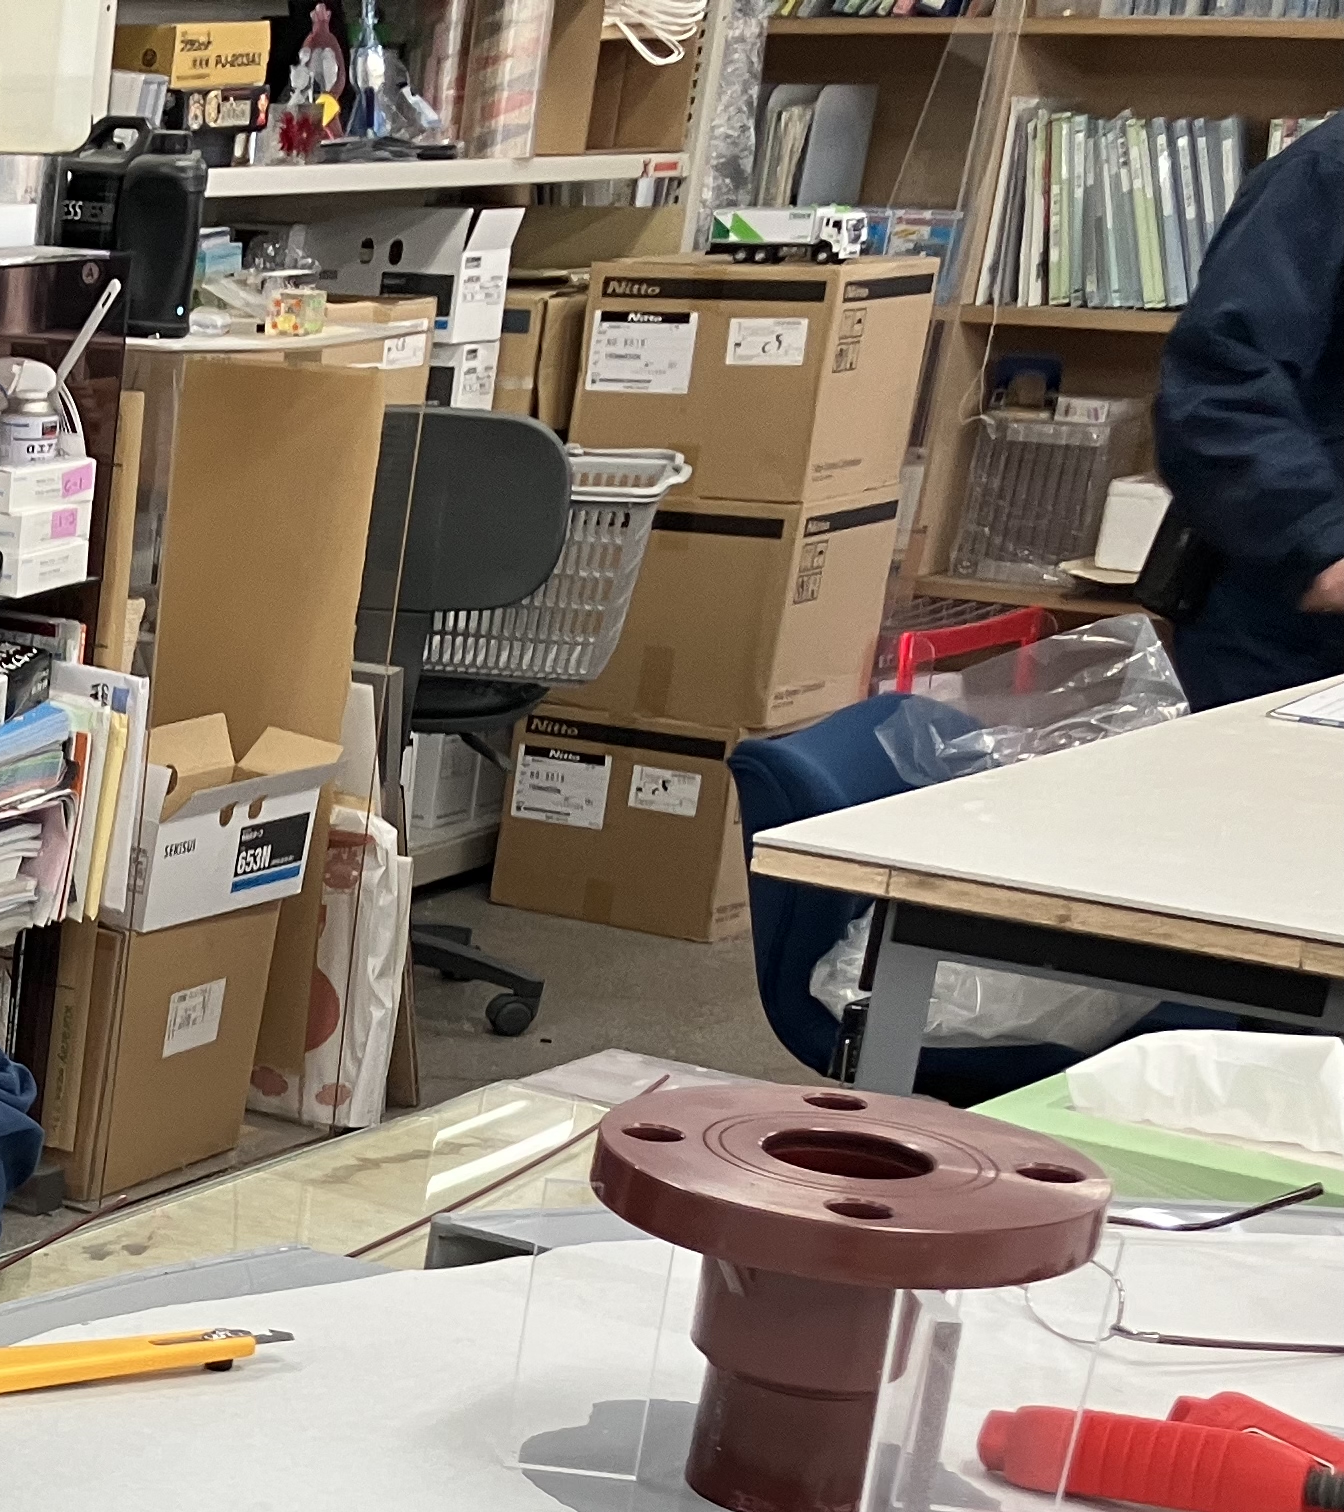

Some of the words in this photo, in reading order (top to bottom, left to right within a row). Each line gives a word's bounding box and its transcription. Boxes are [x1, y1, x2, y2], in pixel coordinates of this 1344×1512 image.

[607, 281, 660, 296] Nitto
[627, 312, 662, 323] Nitto
[531, 718, 579, 737] Nitto
[549, 749, 581, 762] Nitto
[164, 838, 196, 860] SEKISUI
[237, 844, 272, 875] 653N
